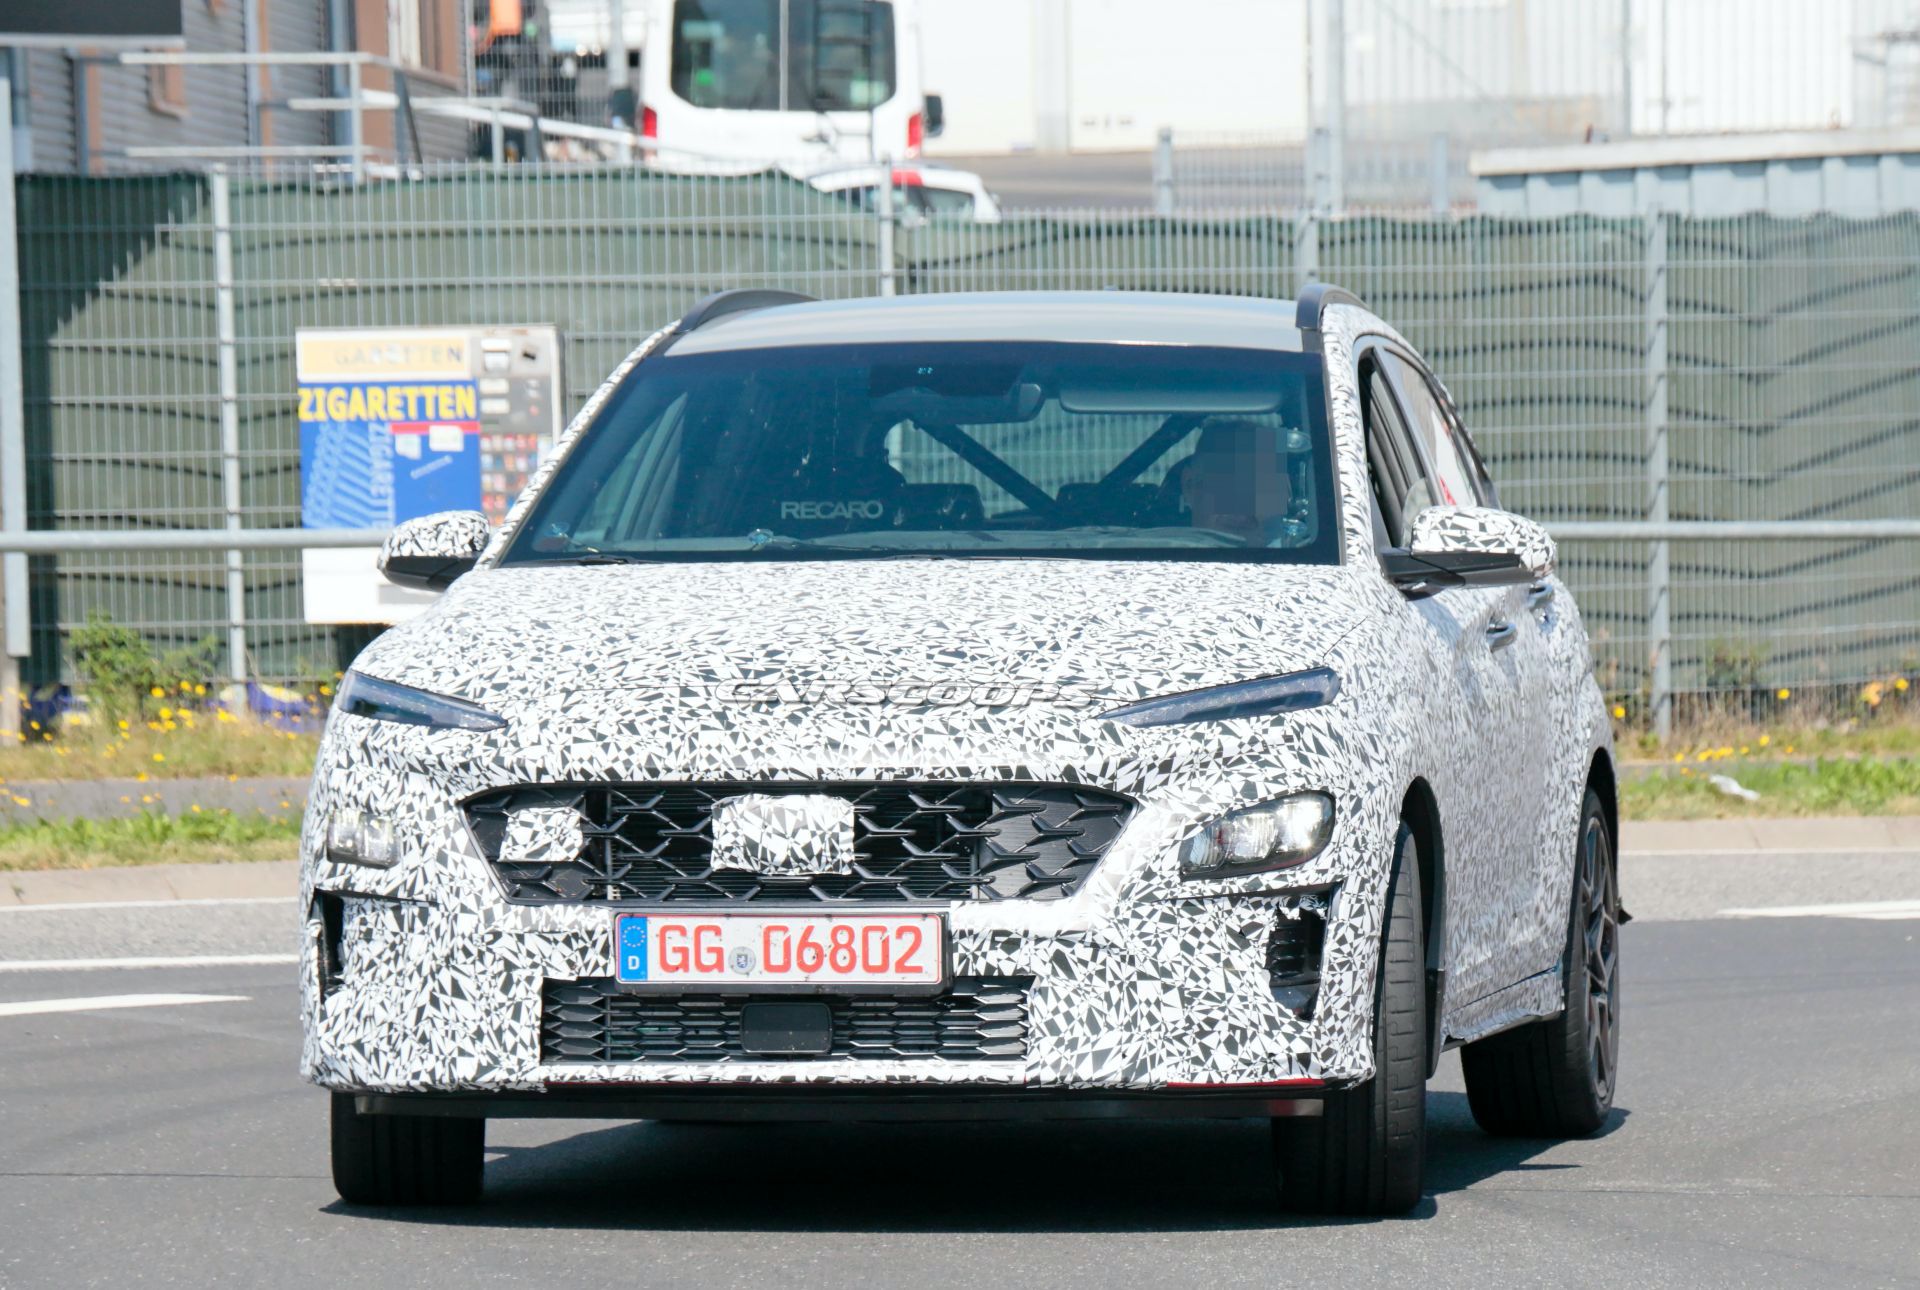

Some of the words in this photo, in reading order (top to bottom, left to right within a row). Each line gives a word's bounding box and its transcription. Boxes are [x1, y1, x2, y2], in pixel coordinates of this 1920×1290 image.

[298, 385, 477, 422] ZIGARETTEN
[781, 500, 884, 520] RECARO
[628, 955, 640, 970] D
[658, 924, 725, 974] GG
[762, 924, 923, 974] 06802
